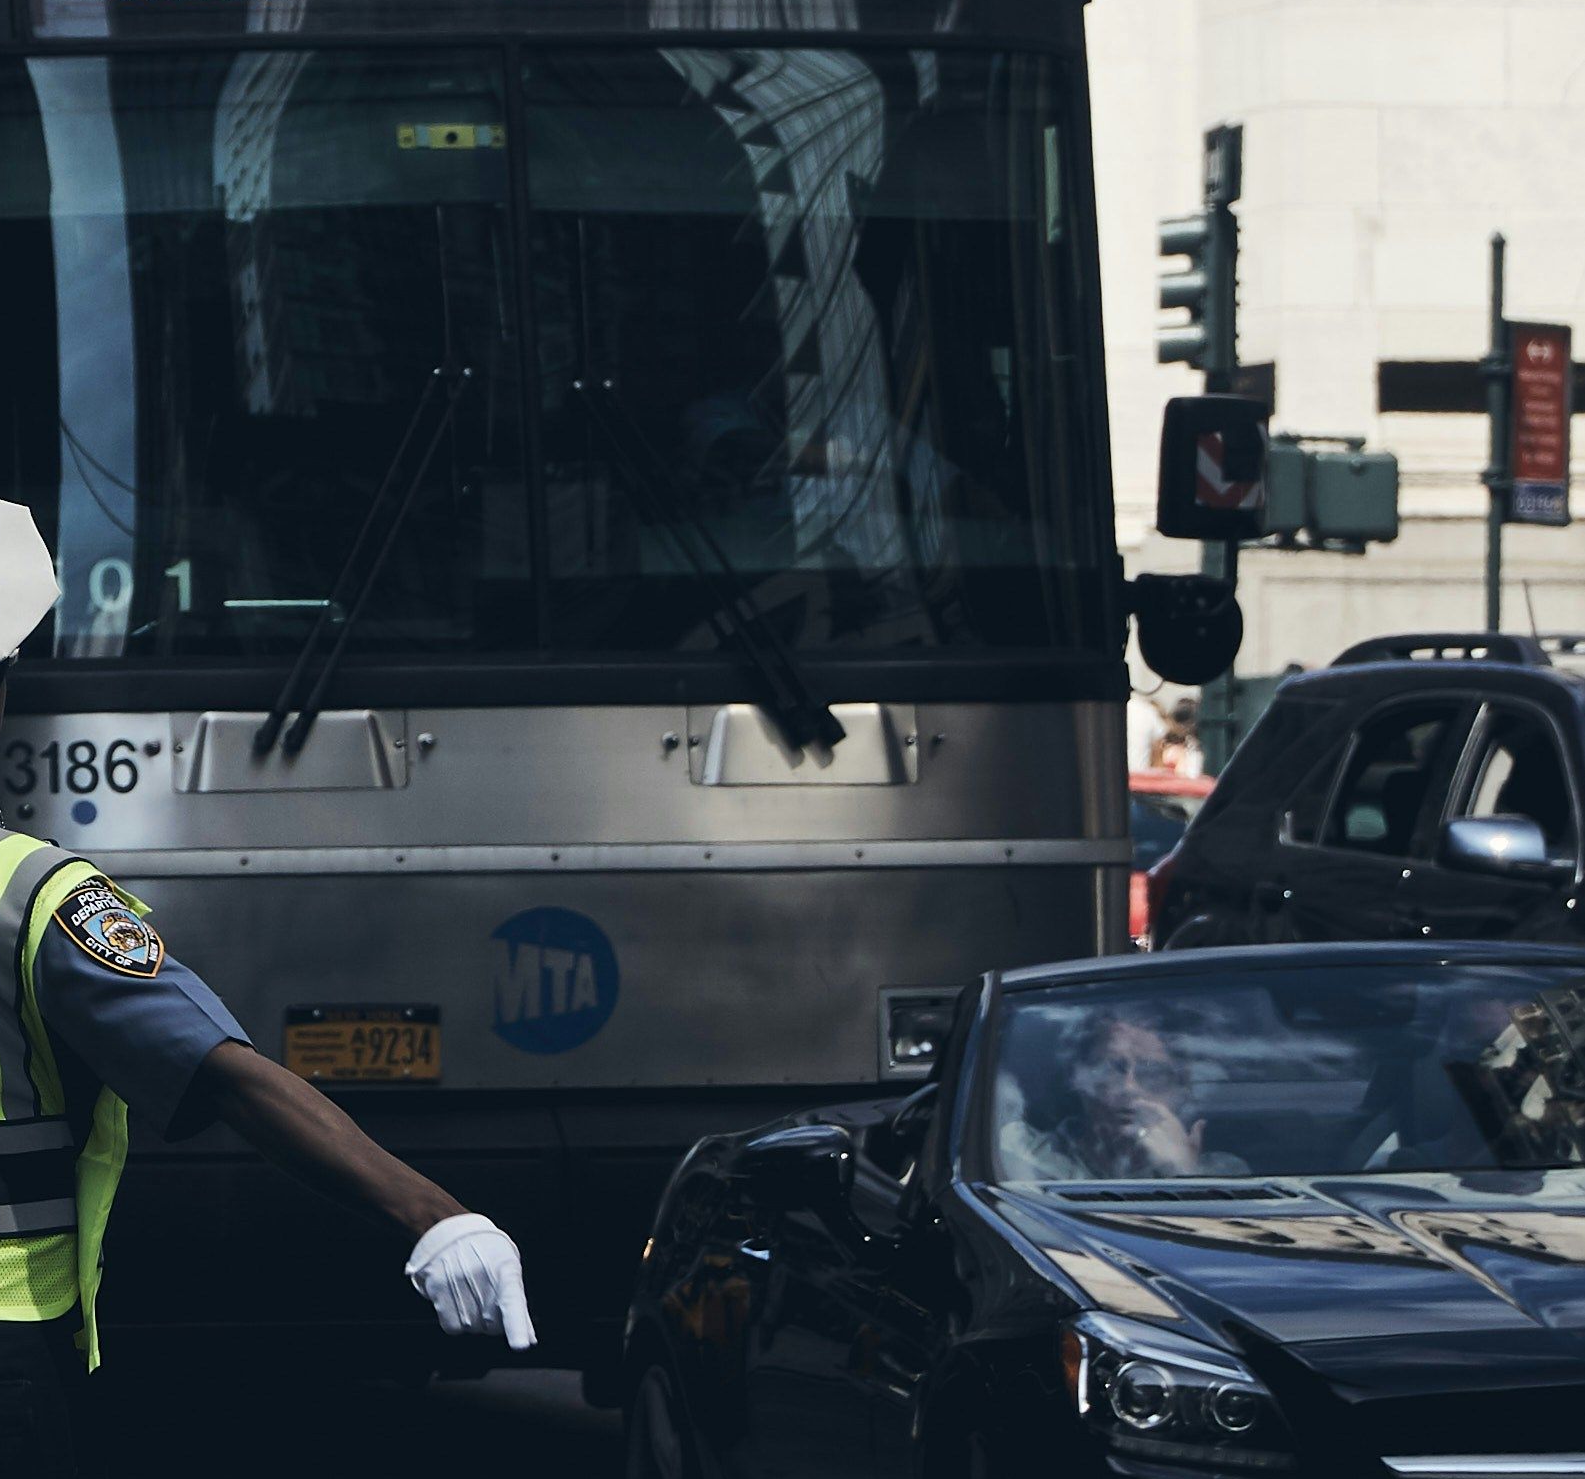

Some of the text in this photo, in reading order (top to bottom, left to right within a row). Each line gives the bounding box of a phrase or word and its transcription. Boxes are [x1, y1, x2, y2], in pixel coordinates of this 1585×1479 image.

[5, 739, 138, 795] 3186
[85, 937, 114, 958] CITY
[114, 955, 133, 967] OF
[490, 936, 599, 1025] MTA
